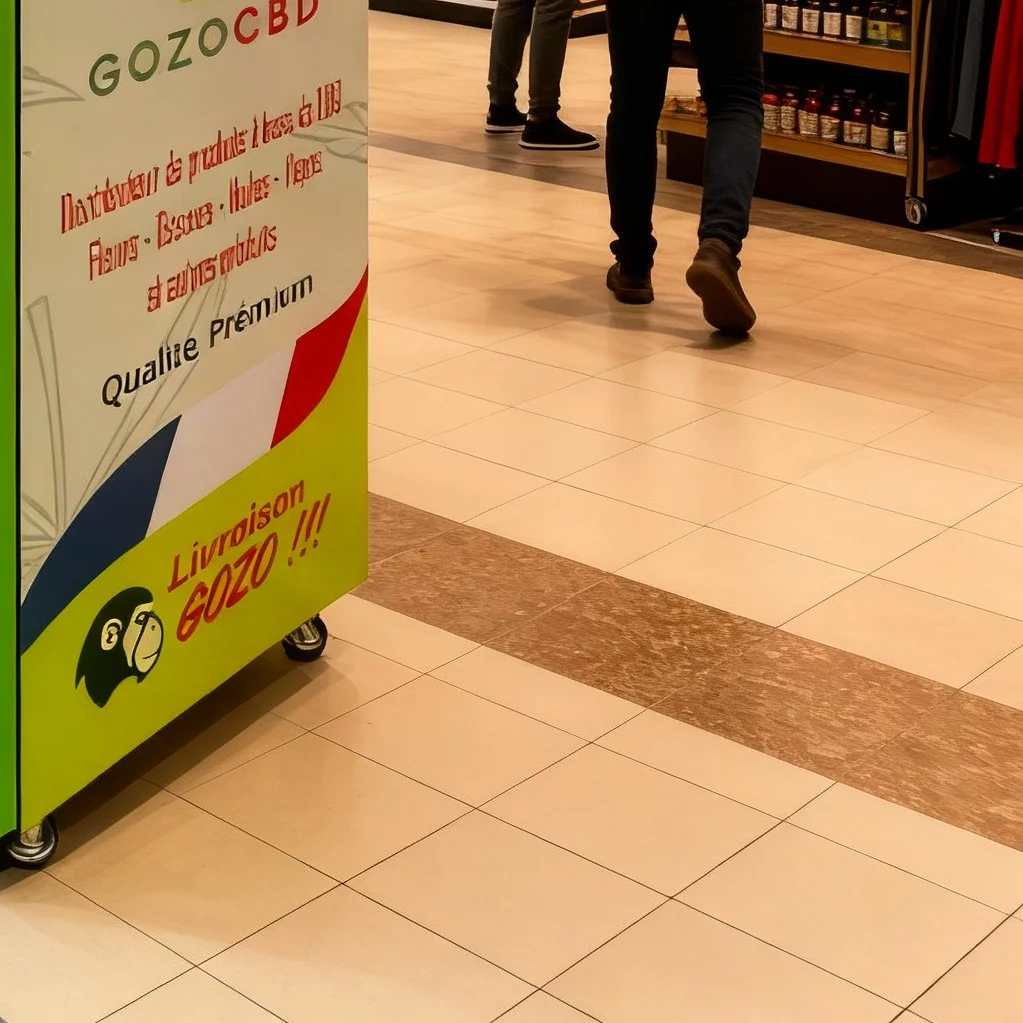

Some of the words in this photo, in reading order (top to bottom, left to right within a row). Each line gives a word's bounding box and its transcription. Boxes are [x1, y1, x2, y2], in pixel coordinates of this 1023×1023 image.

[167, 479, 305, 593] Livraison
[176, 531, 278, 643] GOZO
[287, 492, 331, 567] !!!
